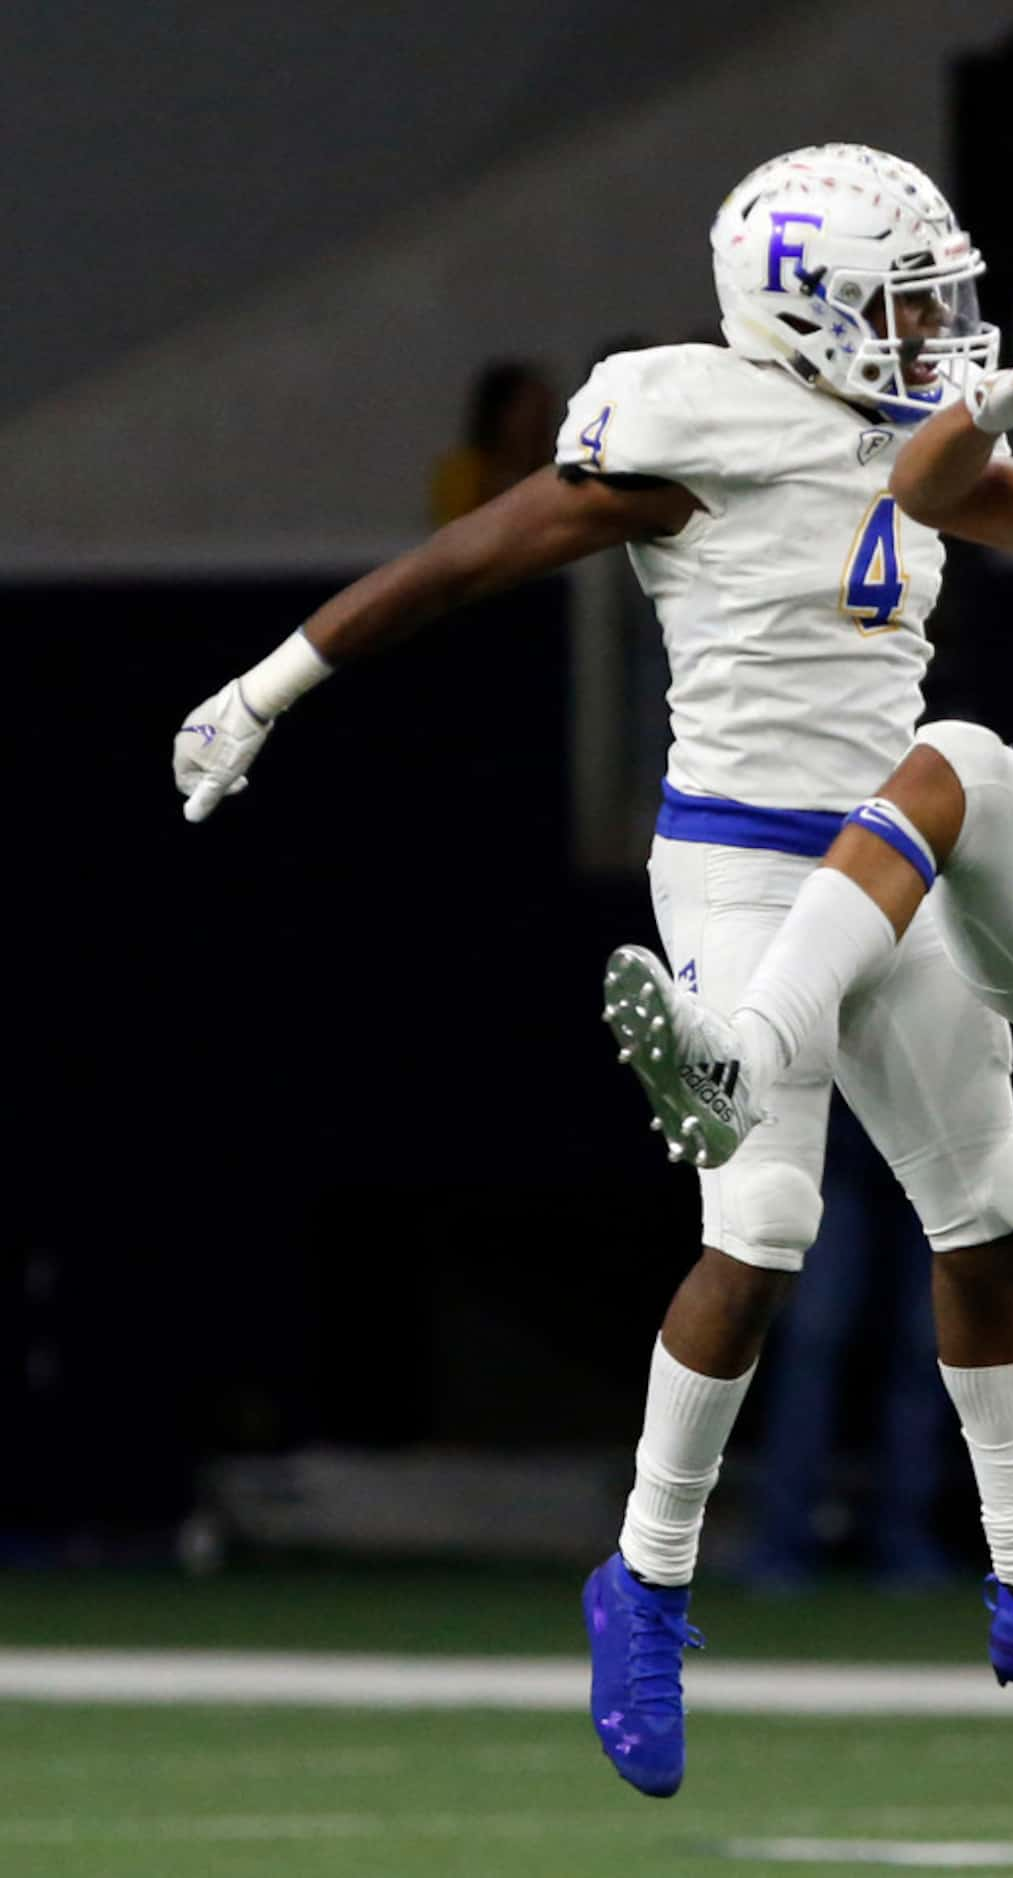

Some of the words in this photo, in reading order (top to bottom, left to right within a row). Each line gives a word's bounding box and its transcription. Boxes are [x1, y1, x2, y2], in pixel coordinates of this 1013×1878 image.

[762, 211, 824, 293] F
[578, 404, 614, 469] 4
[841, 488, 910, 636] 4
[678, 1064, 736, 1122] adidas
